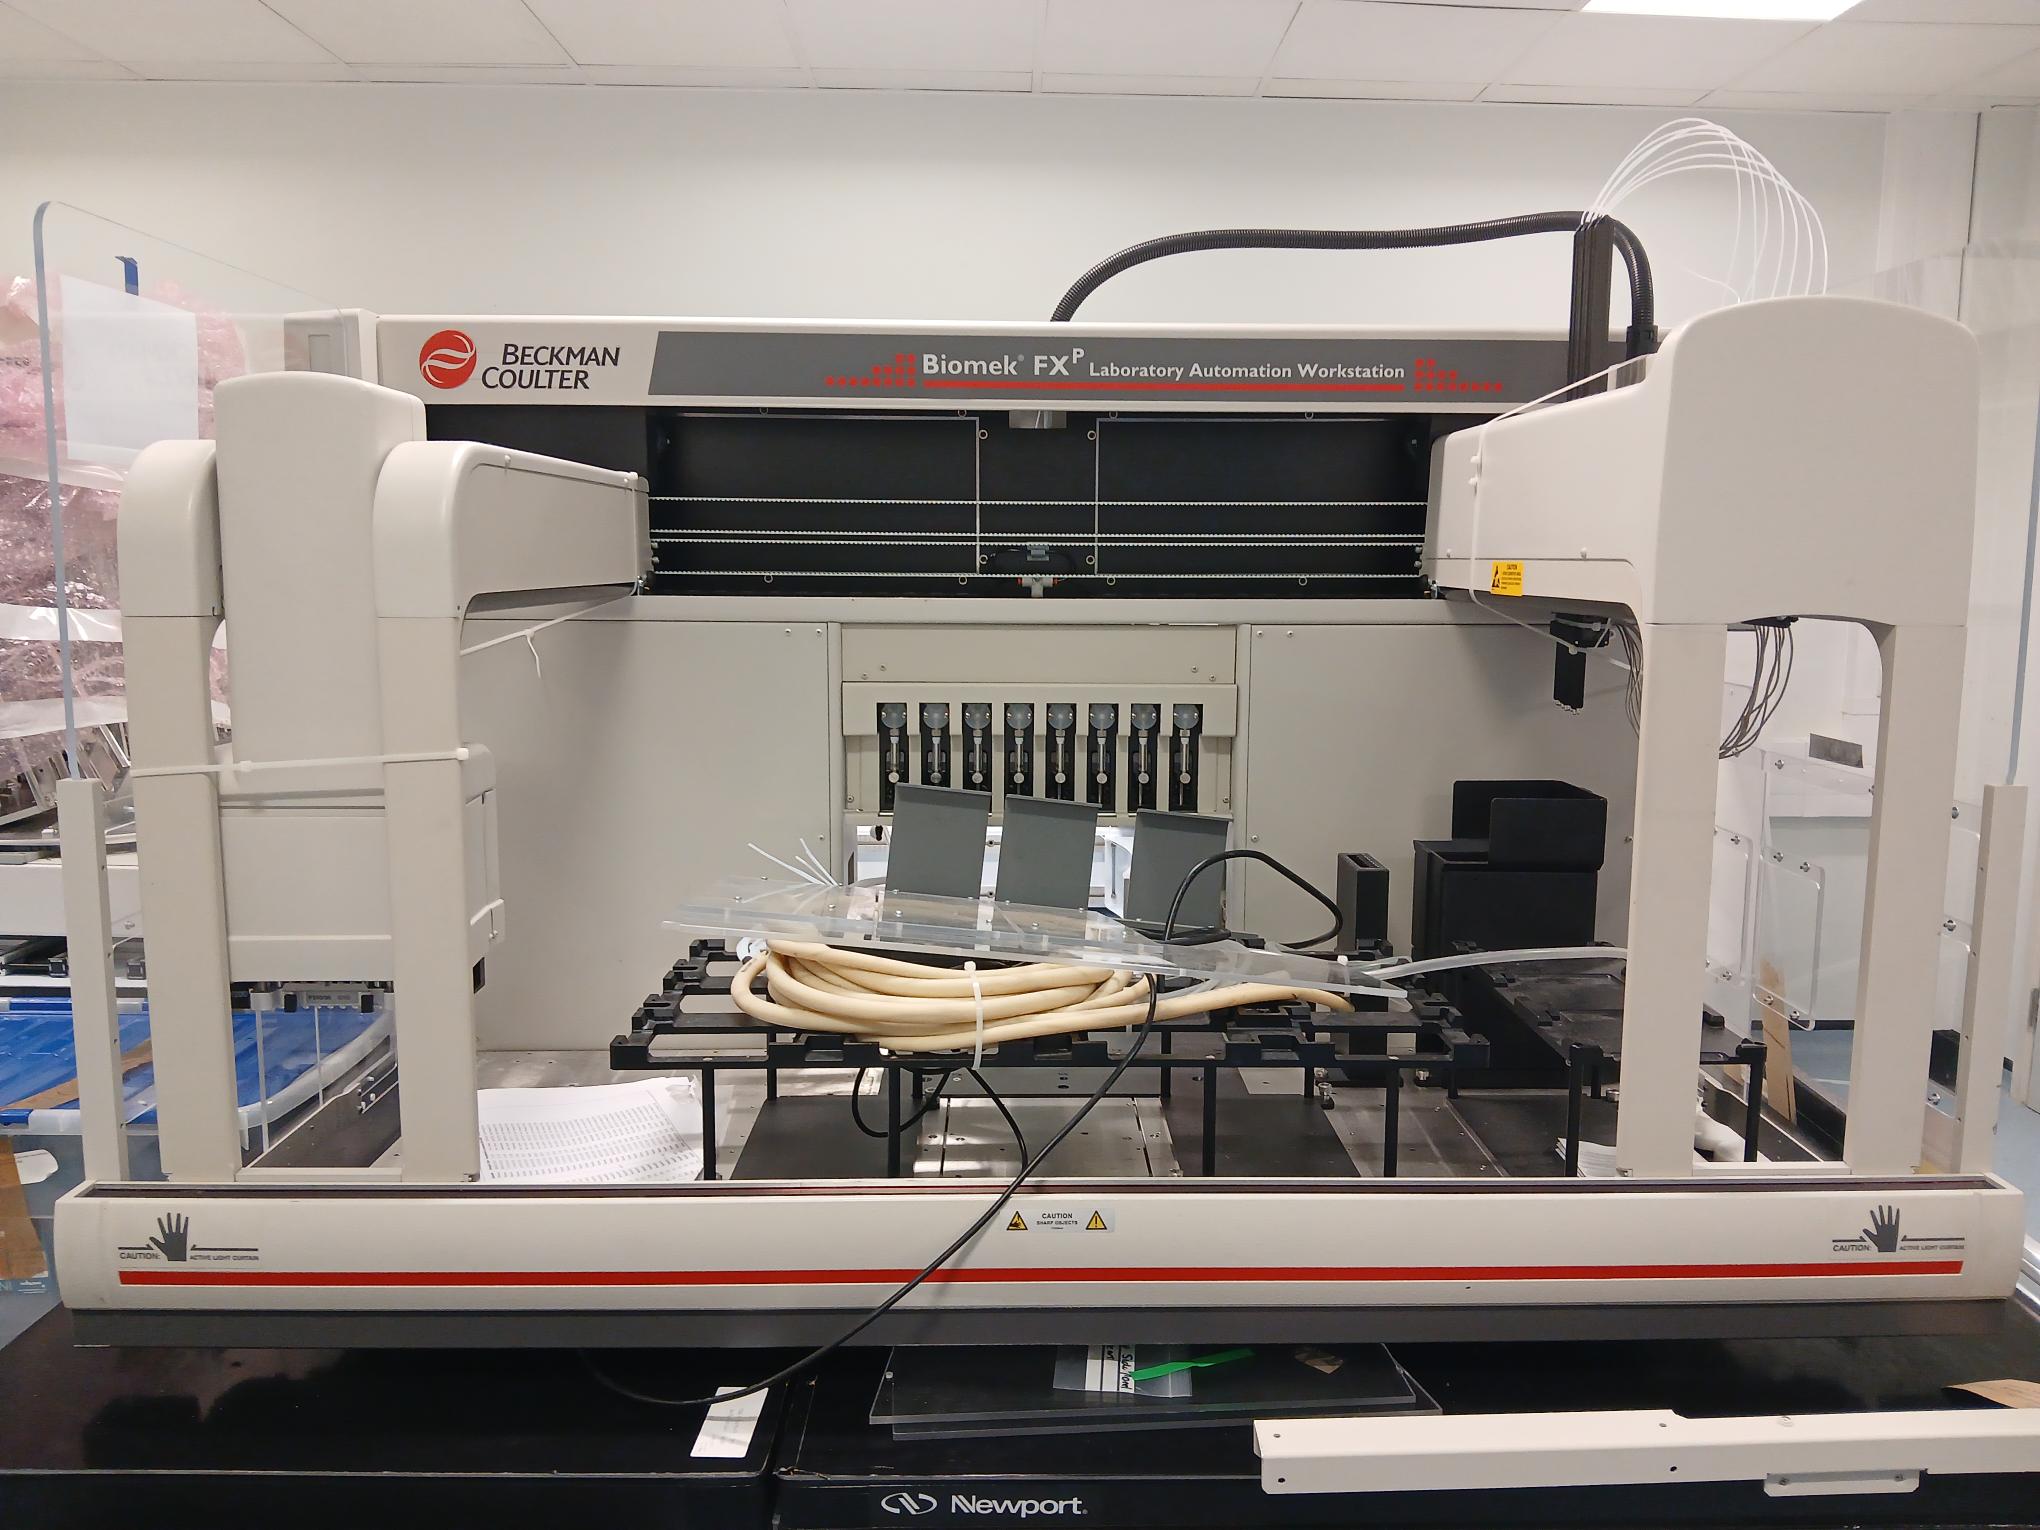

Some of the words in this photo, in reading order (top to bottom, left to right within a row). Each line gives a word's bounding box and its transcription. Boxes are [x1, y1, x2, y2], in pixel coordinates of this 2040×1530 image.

[502, 343, 620, 367] BECKMAN
[922, 353, 1018, 376] Biomek
[1089, 362, 1184, 381] Laboratory
[1189, 362, 1292, 379] Automation
[1298, 363, 1405, 379] Workstation
[481, 366, 590, 390] COULTER
[951, 1494, 1083, 1518] Newport
